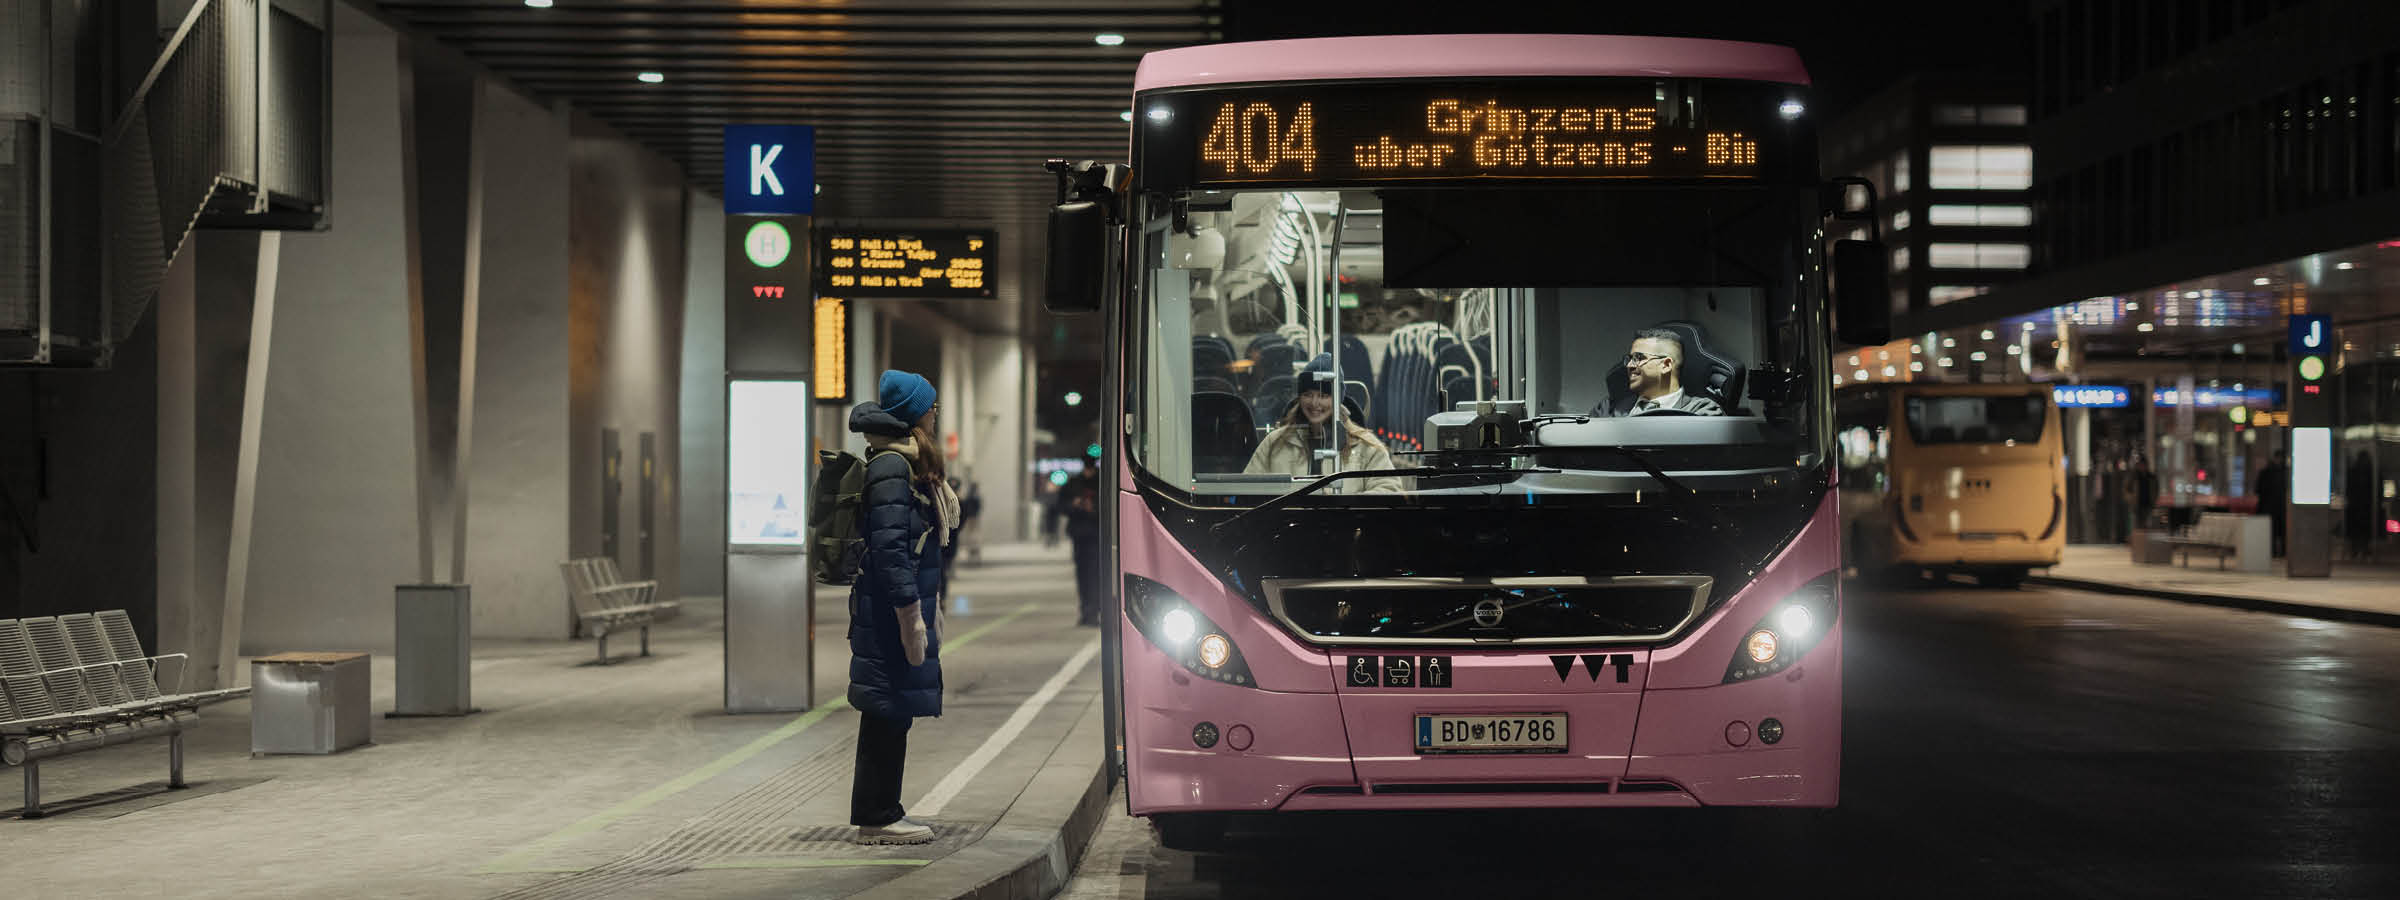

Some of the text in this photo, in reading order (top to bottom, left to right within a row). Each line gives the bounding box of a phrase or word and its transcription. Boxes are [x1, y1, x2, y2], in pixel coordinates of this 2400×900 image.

[1427, 100, 1657, 132] Grinzens
[1204, 102, 1316, 173] 404
[1475, 135, 1652, 166] Götzens
[750, 144, 784, 195] K
[860, 239, 882, 250] Hall
[883, 239, 897, 250] in
[860, 275, 882, 287] Hall
[884, 276, 897, 287] in
[2304, 320, 2321, 348] J
[1549, 654, 1634, 684] VVT
[1442, 720, 1555, 742] BD 16786
